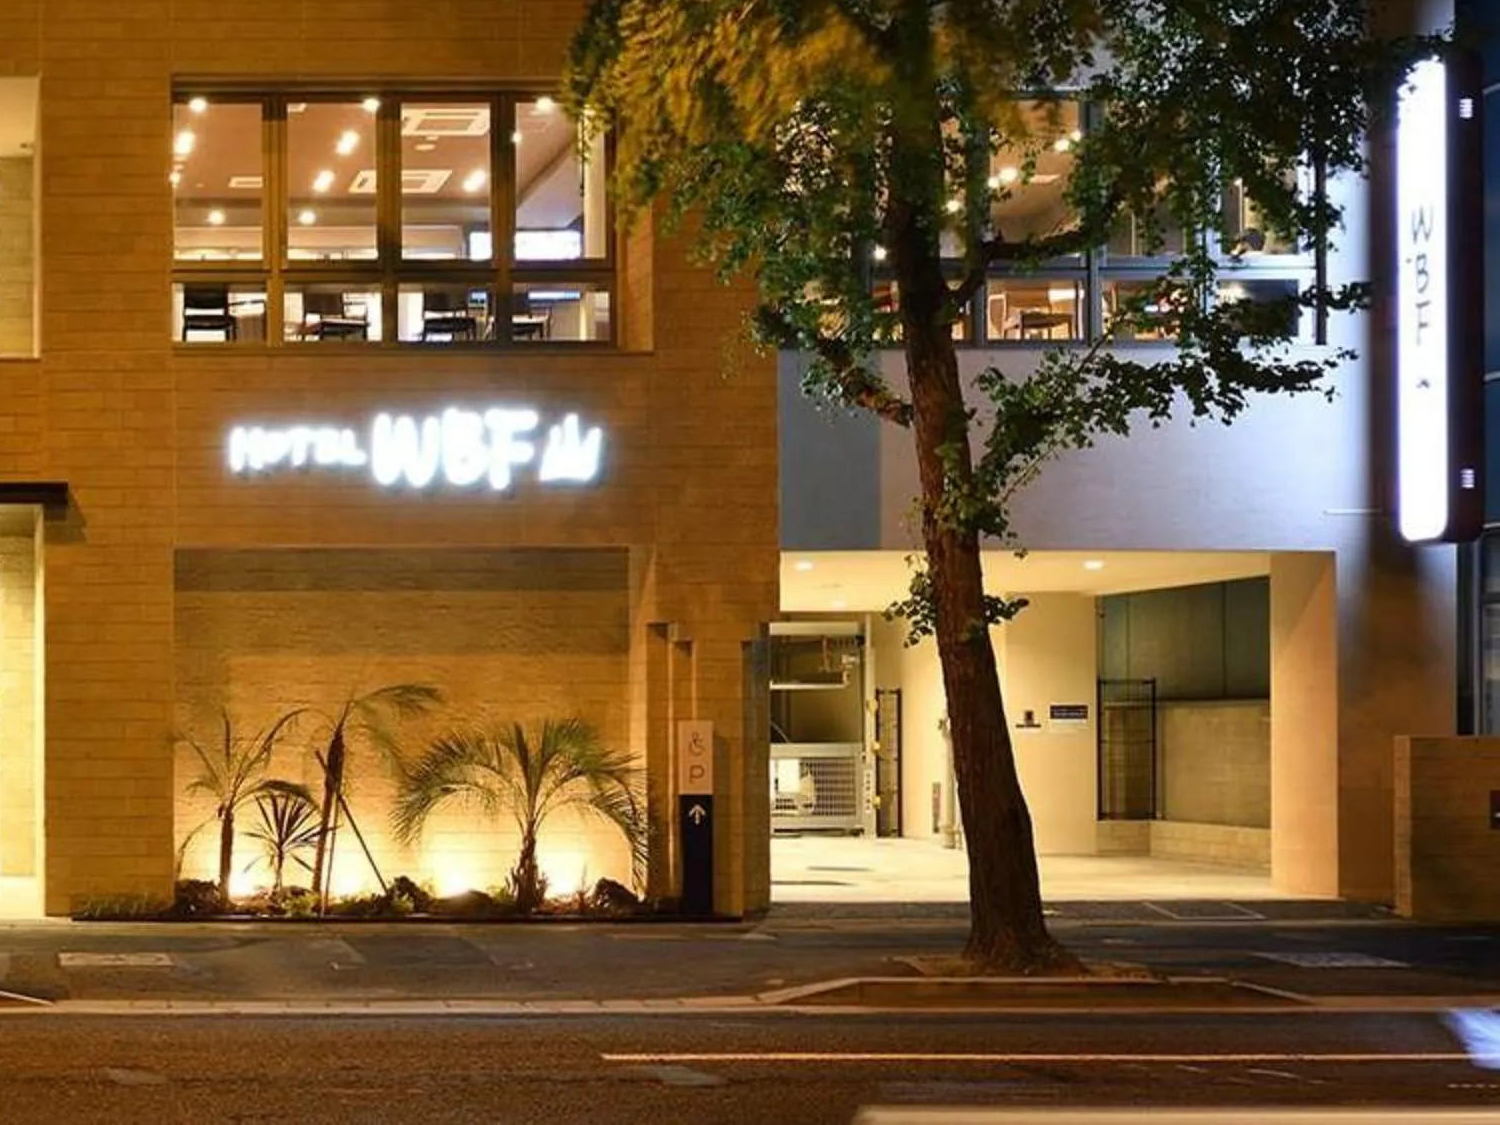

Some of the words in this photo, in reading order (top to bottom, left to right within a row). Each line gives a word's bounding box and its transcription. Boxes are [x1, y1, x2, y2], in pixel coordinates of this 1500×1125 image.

[1410, 201, 1435, 348] WBF
[228, 425, 368, 472] HOTEL
[371, 406, 539, 491] WBF
[689, 764, 706, 784] P
